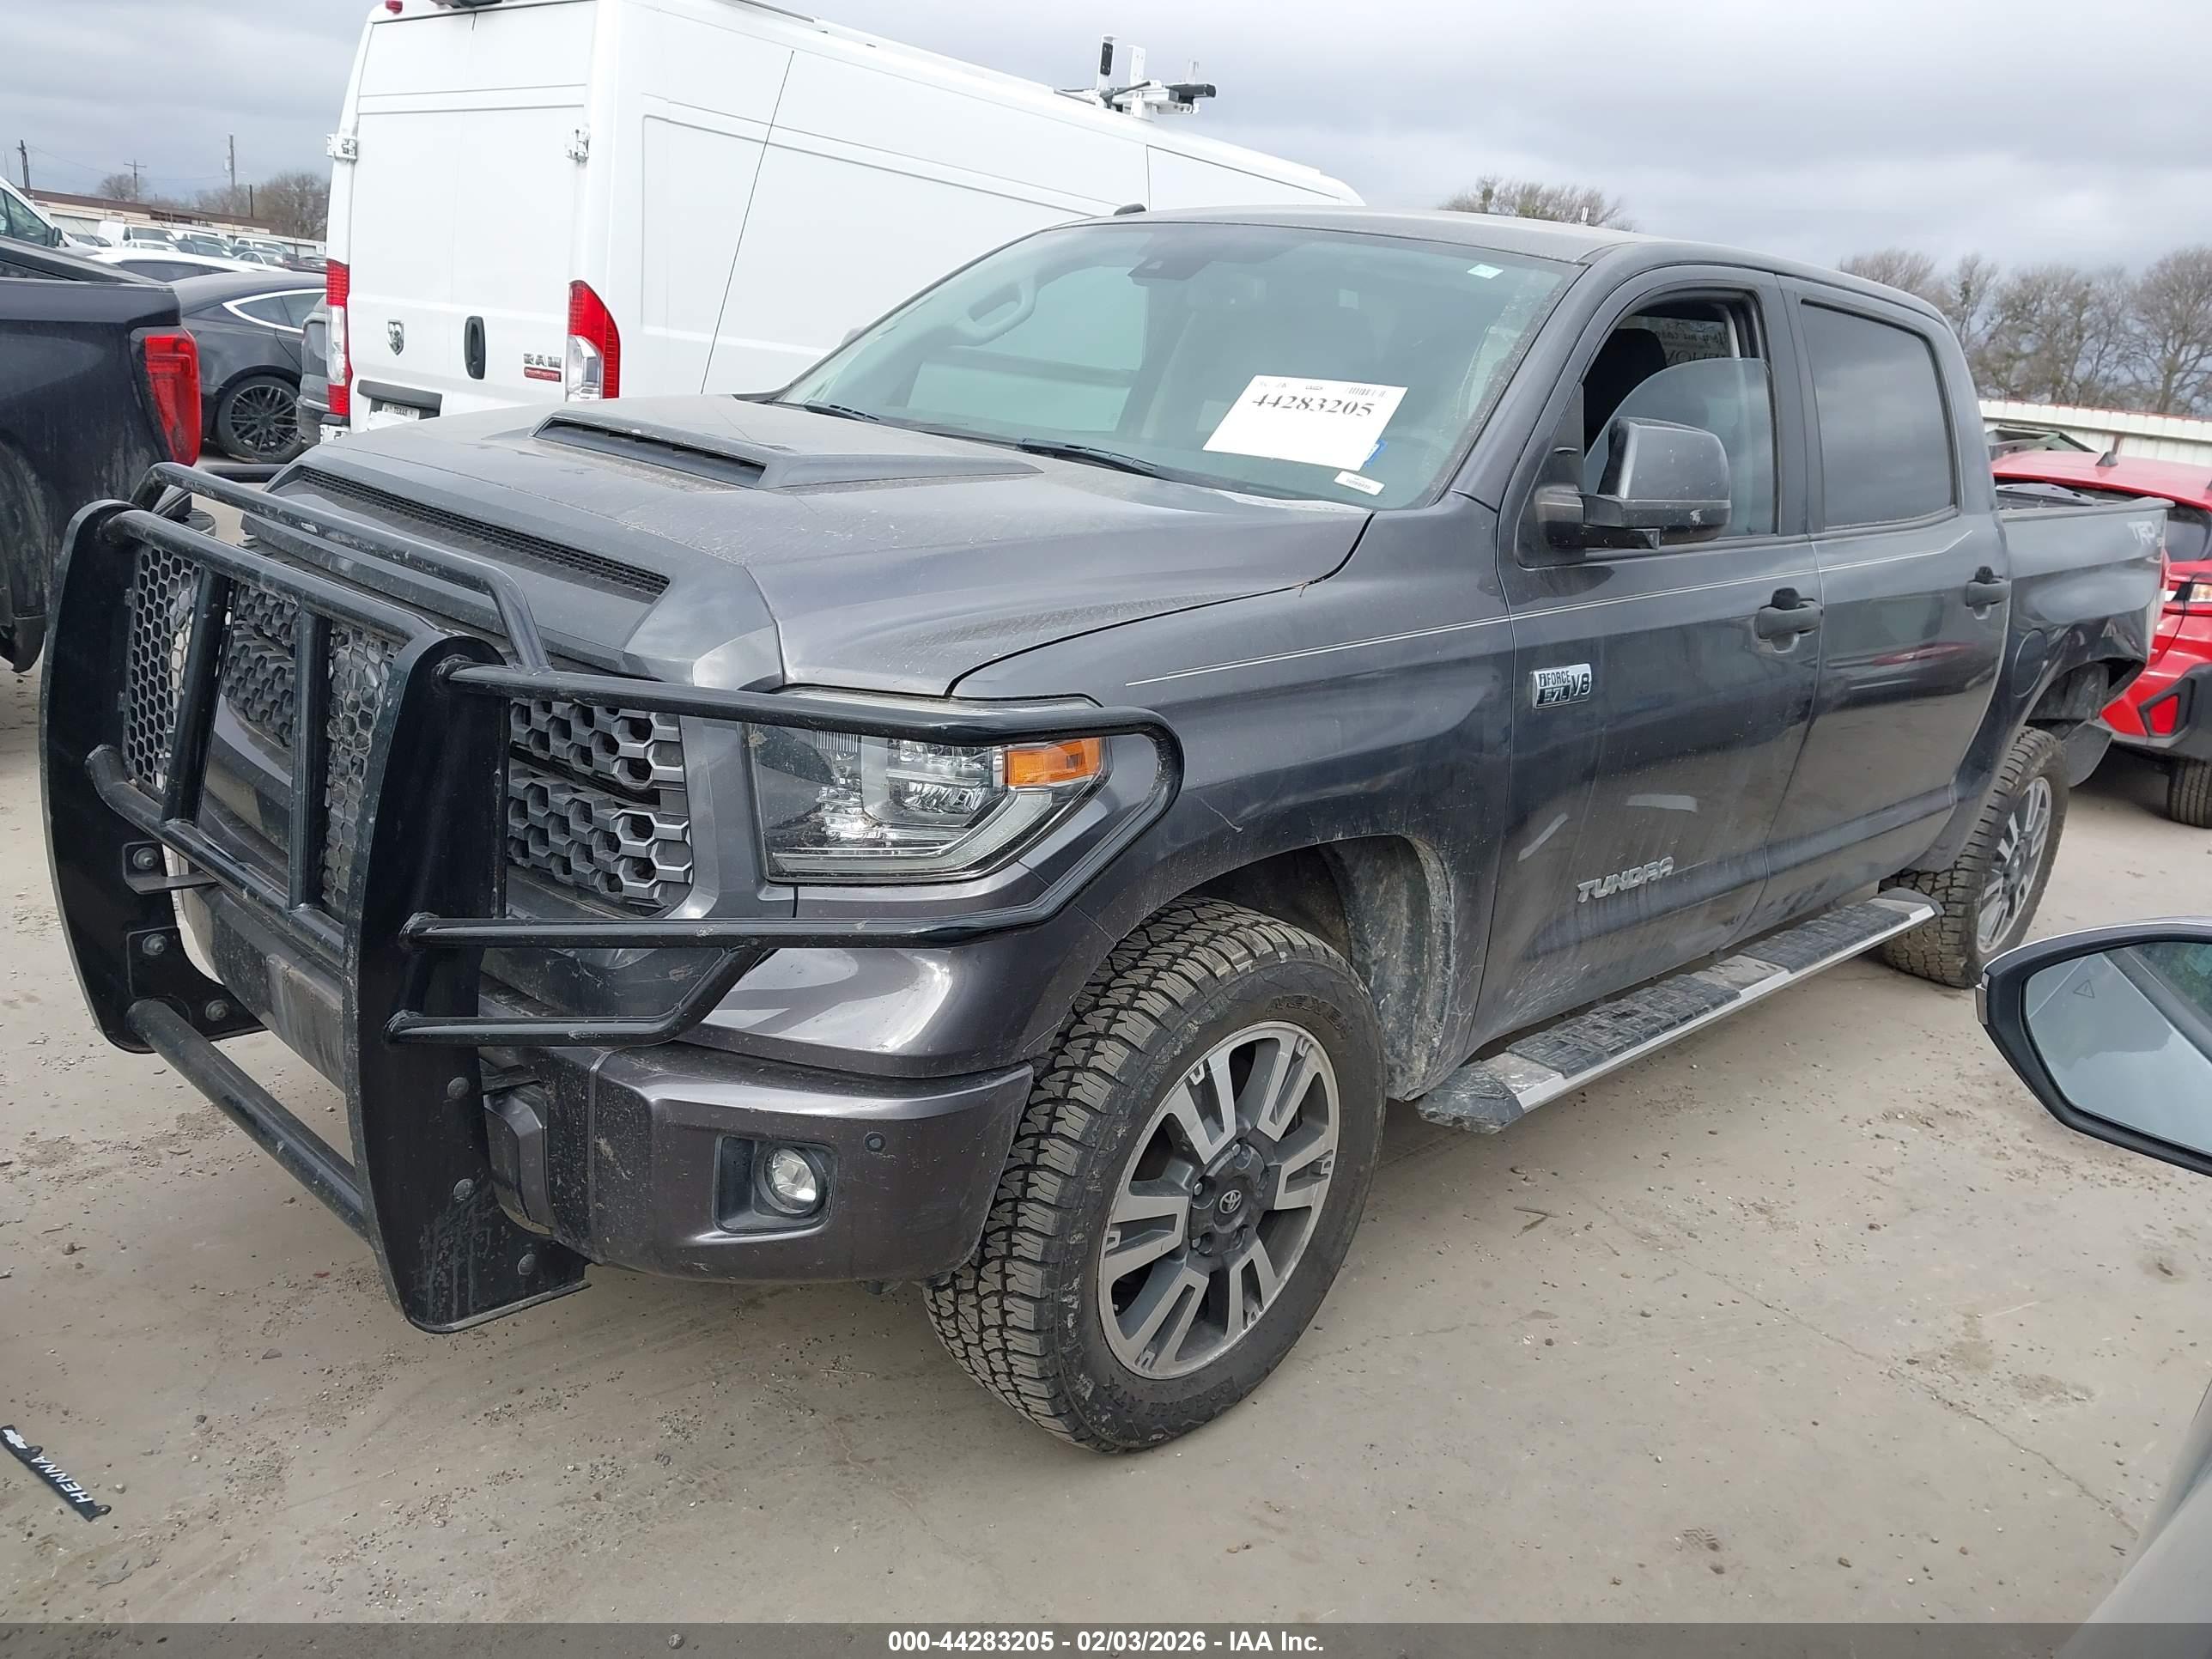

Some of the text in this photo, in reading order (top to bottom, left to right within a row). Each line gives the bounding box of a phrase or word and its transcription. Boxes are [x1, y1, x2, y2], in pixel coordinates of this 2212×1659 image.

[1252, 394, 1375, 416] 44283205
[1571, 673, 1591, 696] V8
[1577, 856, 1674, 903] TUNDRA
